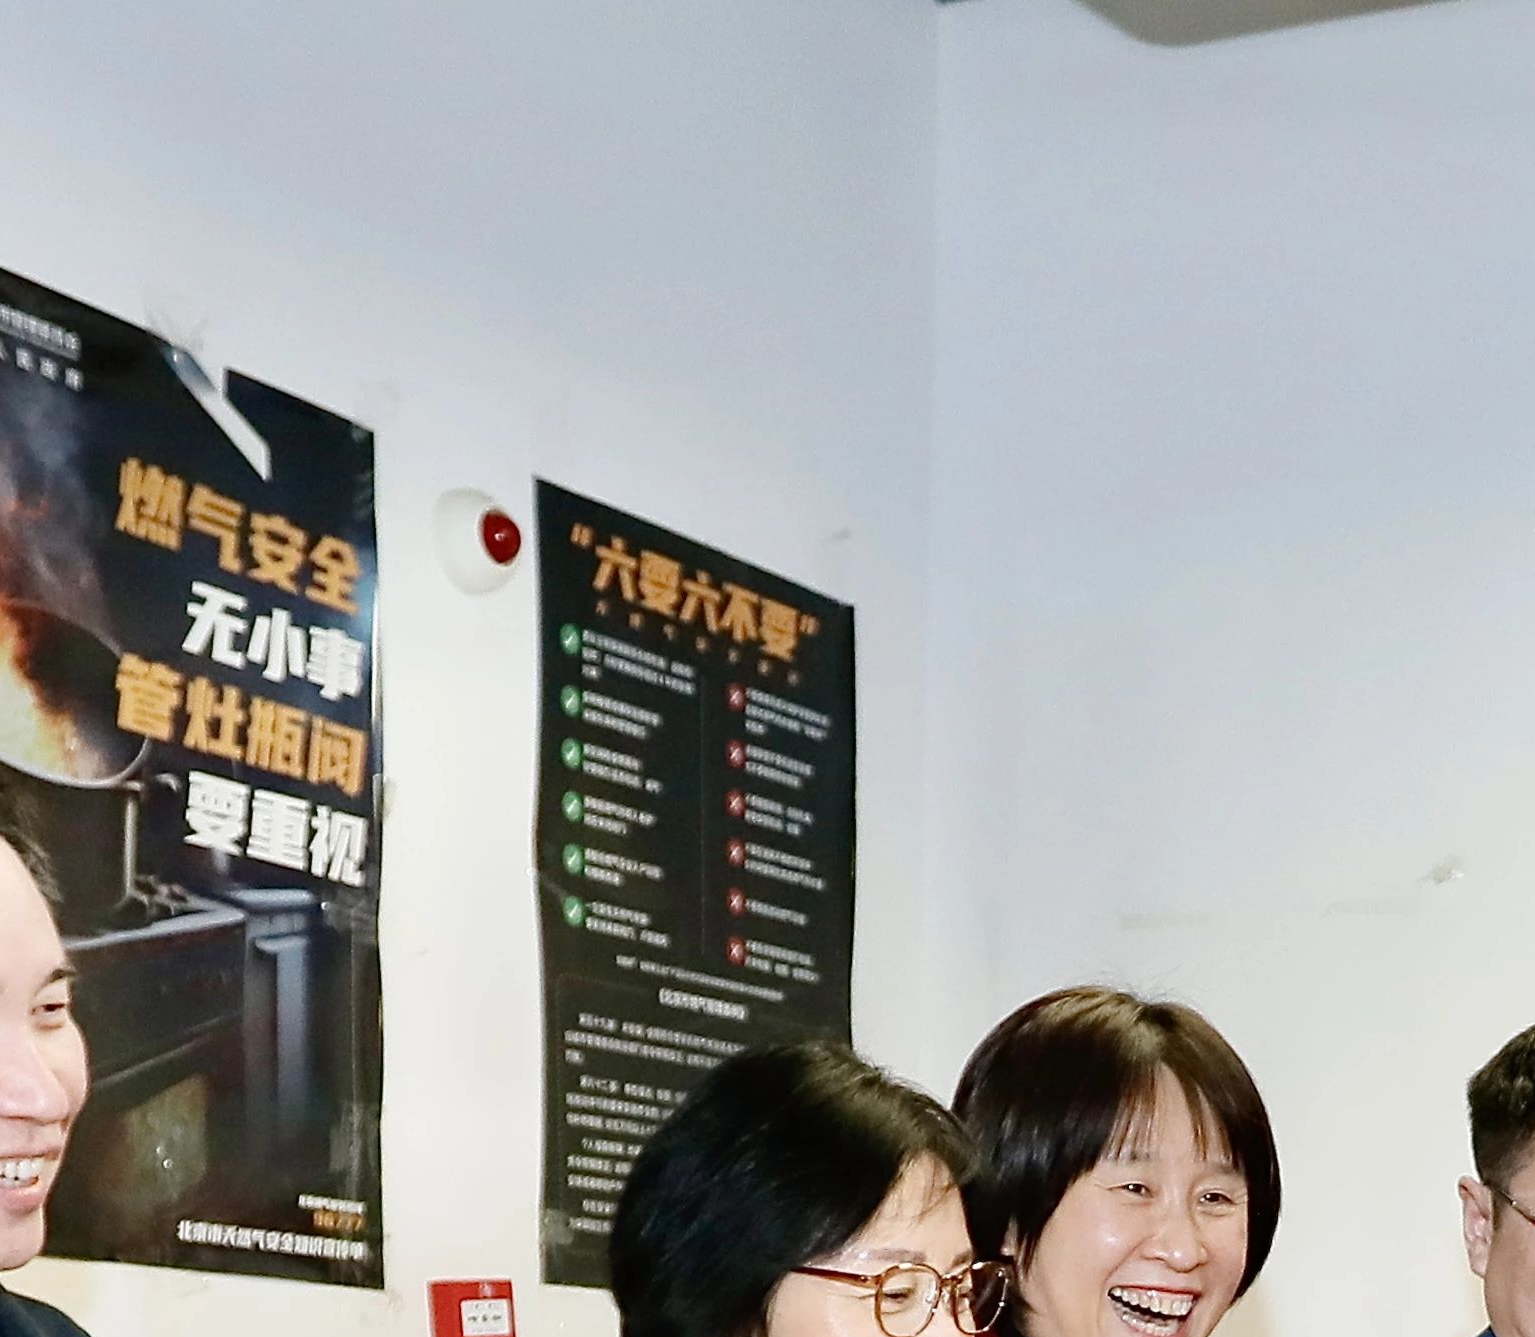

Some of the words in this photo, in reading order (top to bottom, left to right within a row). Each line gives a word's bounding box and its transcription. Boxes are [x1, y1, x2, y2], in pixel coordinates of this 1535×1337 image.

[114, 456, 362, 616] 燃气安全
[181, 580, 366, 701] 无小事
[115, 652, 368, 799] 管灶瓶阀
[182, 770, 367, 889] 要重视
